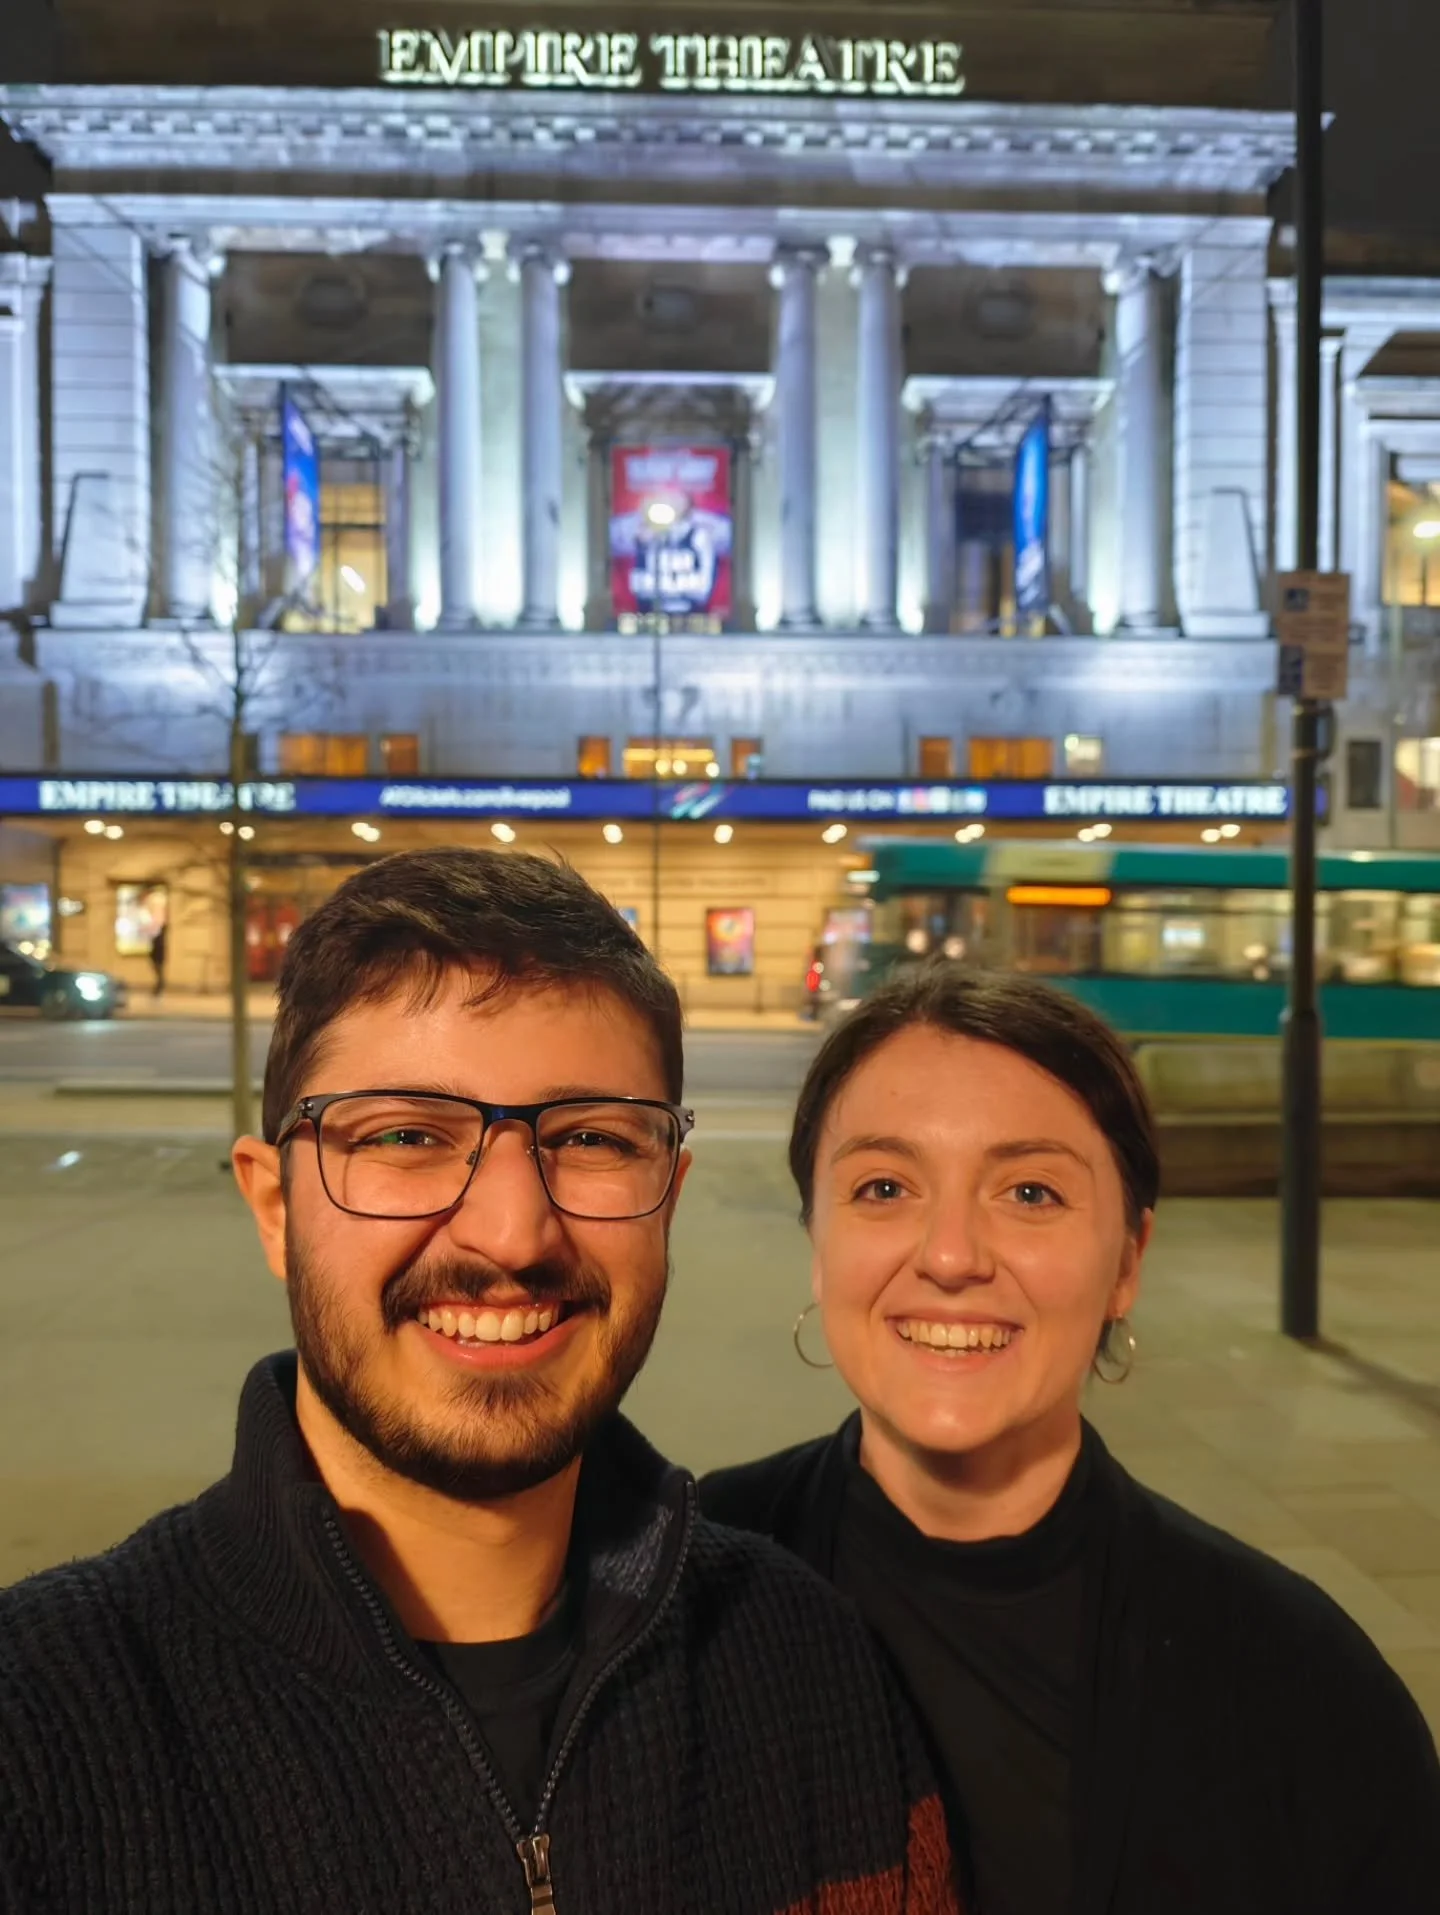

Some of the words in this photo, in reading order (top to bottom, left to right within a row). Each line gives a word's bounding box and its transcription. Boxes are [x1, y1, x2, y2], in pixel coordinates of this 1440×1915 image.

[377, 28, 643, 87] EMPIRE
[650, 33, 966, 95] THEATRE
[39, 780, 156, 810] EMPIRE
[1044, 784, 1154, 815] EMPIRE
[1155, 784, 1287, 815] THEATRE
